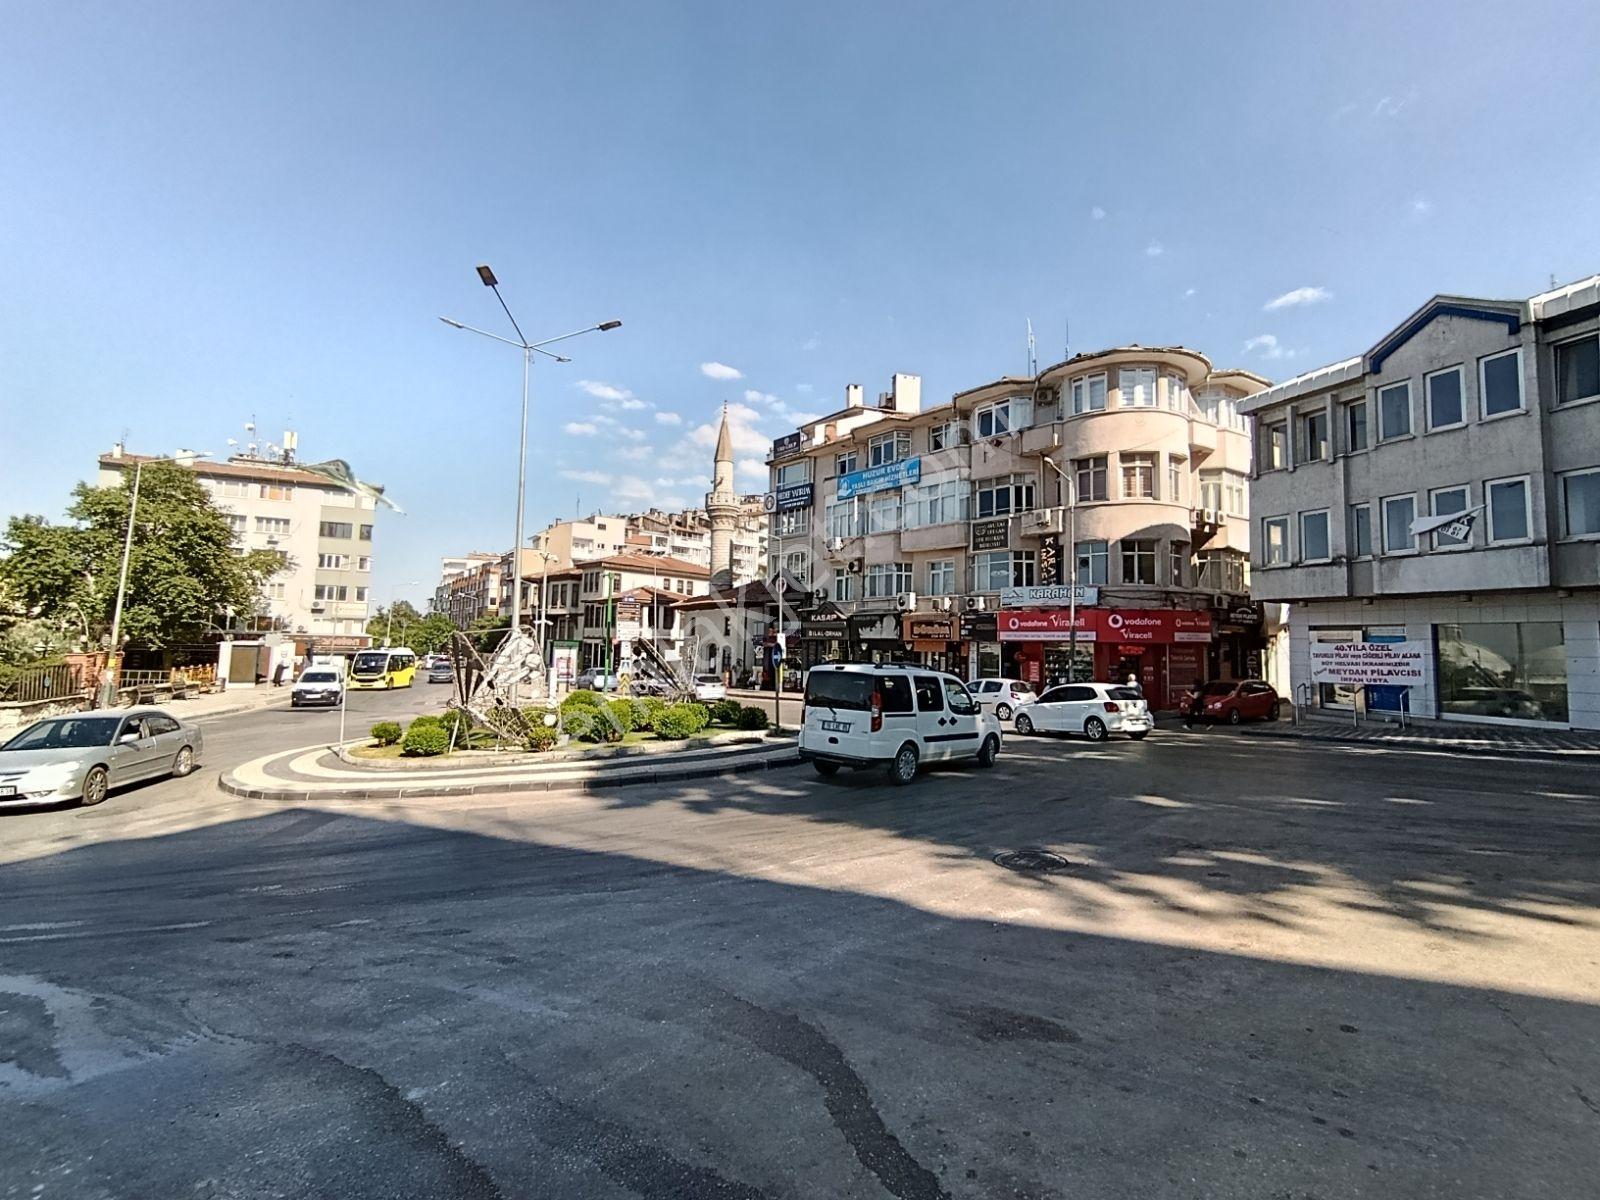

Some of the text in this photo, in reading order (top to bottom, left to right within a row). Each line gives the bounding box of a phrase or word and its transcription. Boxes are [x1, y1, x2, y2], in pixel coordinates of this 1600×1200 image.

[862, 463, 906, 480] HUZUR EVDE
[1020, 619, 1048, 627] vodafone
[1124, 618, 1162, 627] vodafone
[1120, 628, 1153, 639] Viracell
[1368, 644, 1393, 652] ÖZEL
[1328, 668, 1368, 676] MEYDAN
[1370, 668, 1422, 677] PİLAVCISI
